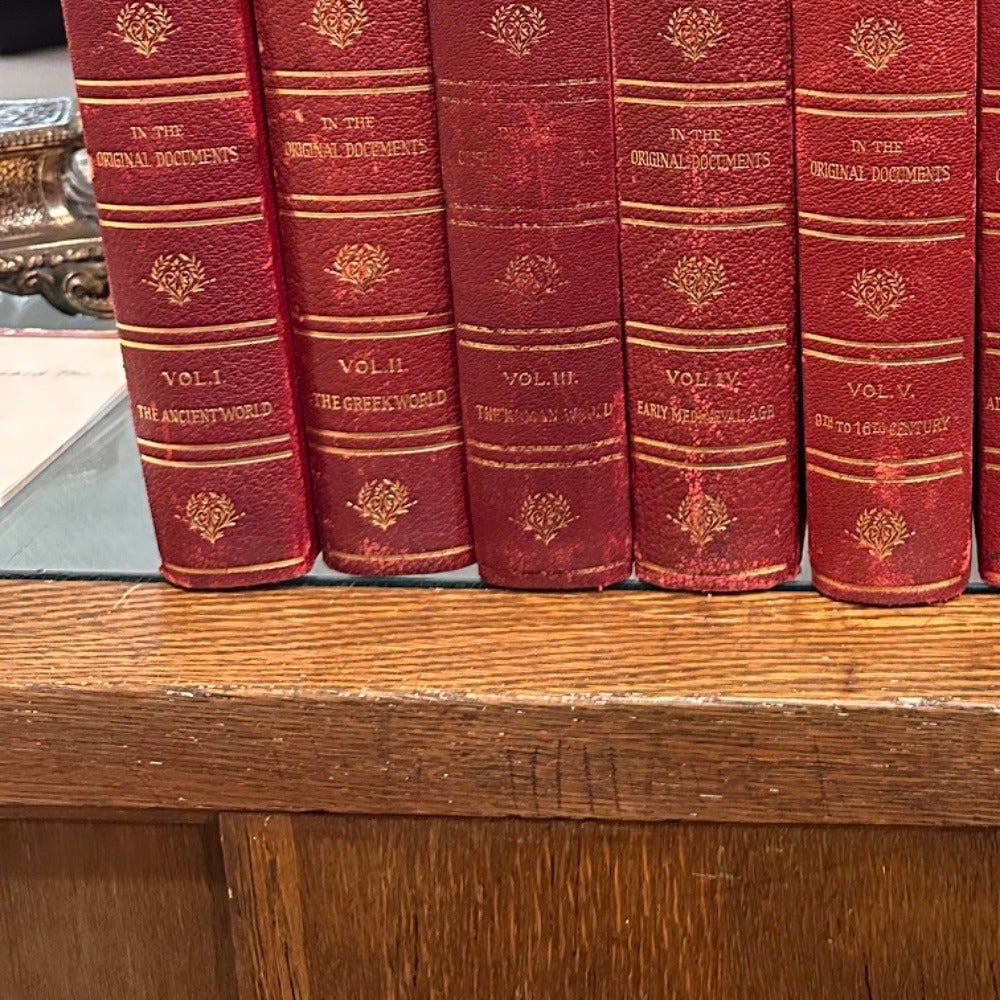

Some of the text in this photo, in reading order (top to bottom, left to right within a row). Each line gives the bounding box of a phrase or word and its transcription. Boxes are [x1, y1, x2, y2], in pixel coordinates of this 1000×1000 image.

[130, 125, 185, 139] IN THE
[320, 116, 375, 129] IN THE
[670, 128, 722, 142] IN THE
[344, 138, 428, 158] DOCUMENTS
[850, 139, 904, 154] IN THE
[97, 146, 238, 169] ORIGINAL DOCUMENTS
[631, 150, 771, 170] ORIGINAL DOCUMENTS
[810, 161, 951, 183] ORIGINAL DOCUMENTS
[312, 389, 447, 411] THE GREEK WORLD
[136, 401, 273, 424] THE ANCIENT WORLD
[637, 401, 668, 420] EARLY
[750, 404, 775, 421] AGE
[836, 422, 851, 433] TO
[889, 416, 951, 435] CENTURY
